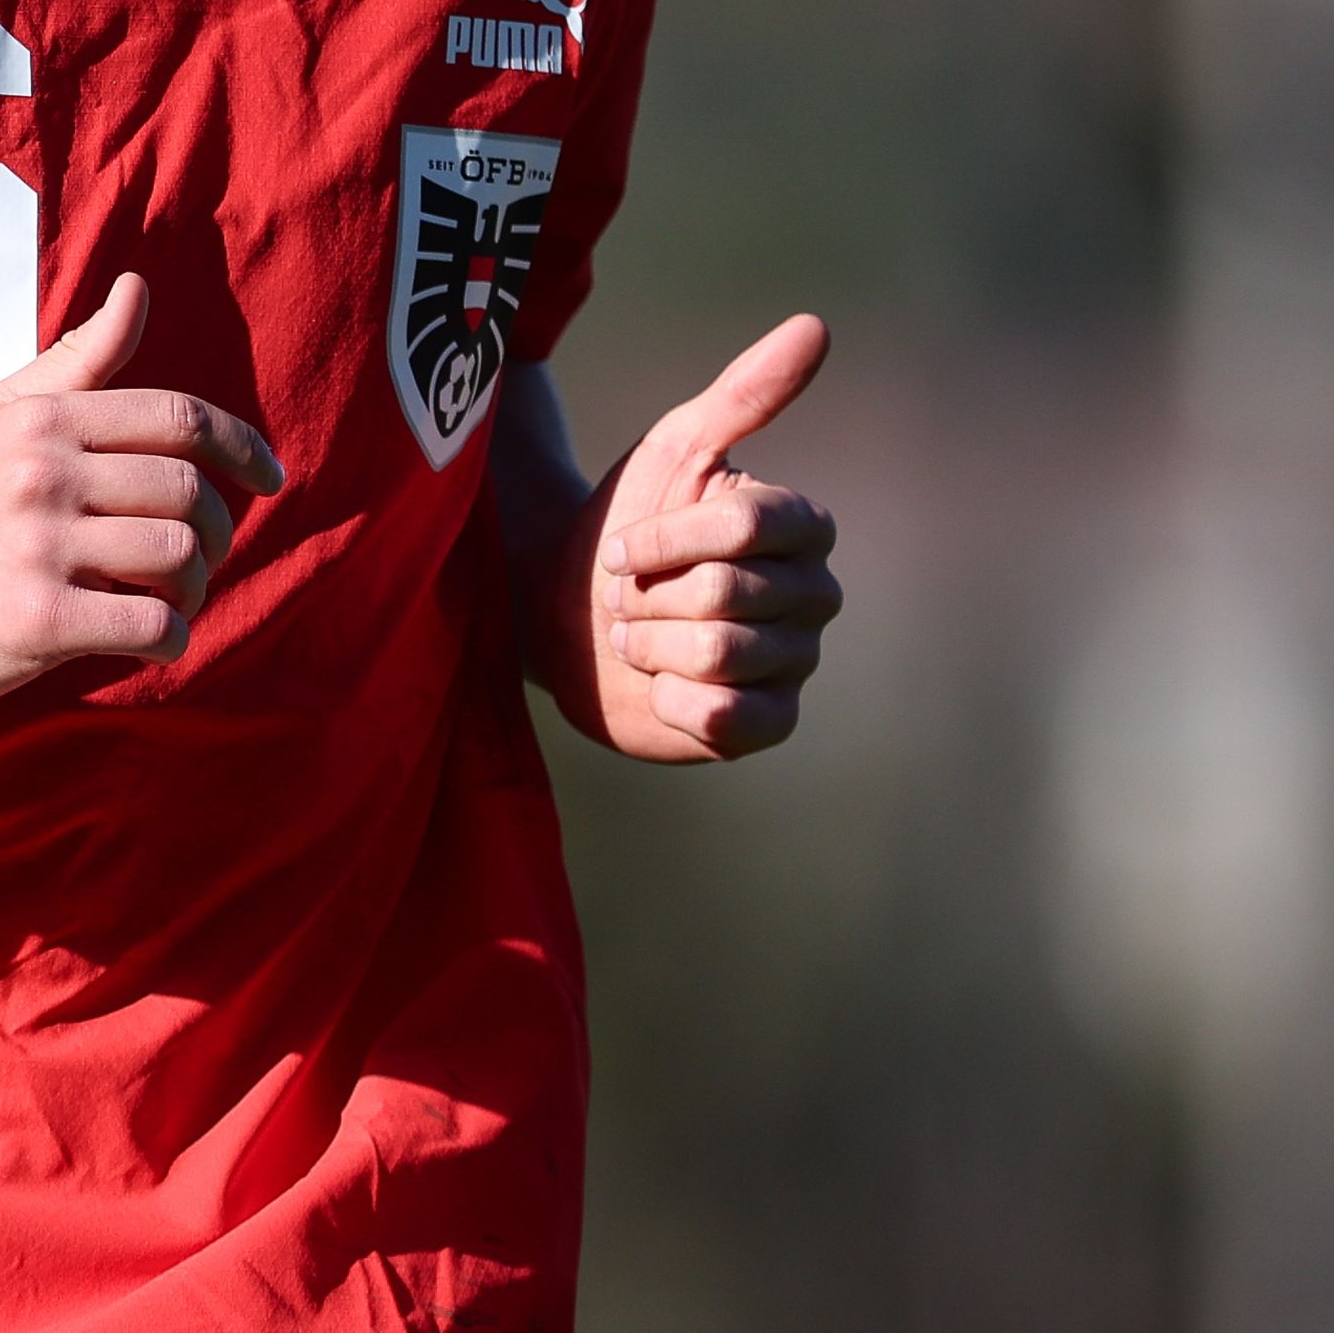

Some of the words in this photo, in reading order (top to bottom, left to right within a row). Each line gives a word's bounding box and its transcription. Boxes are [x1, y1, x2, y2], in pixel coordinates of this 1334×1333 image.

[445, 15, 563, 75] PUMA
[428, 159, 455, 171] SEIT
[460, 149, 526, 185] ÖFB
